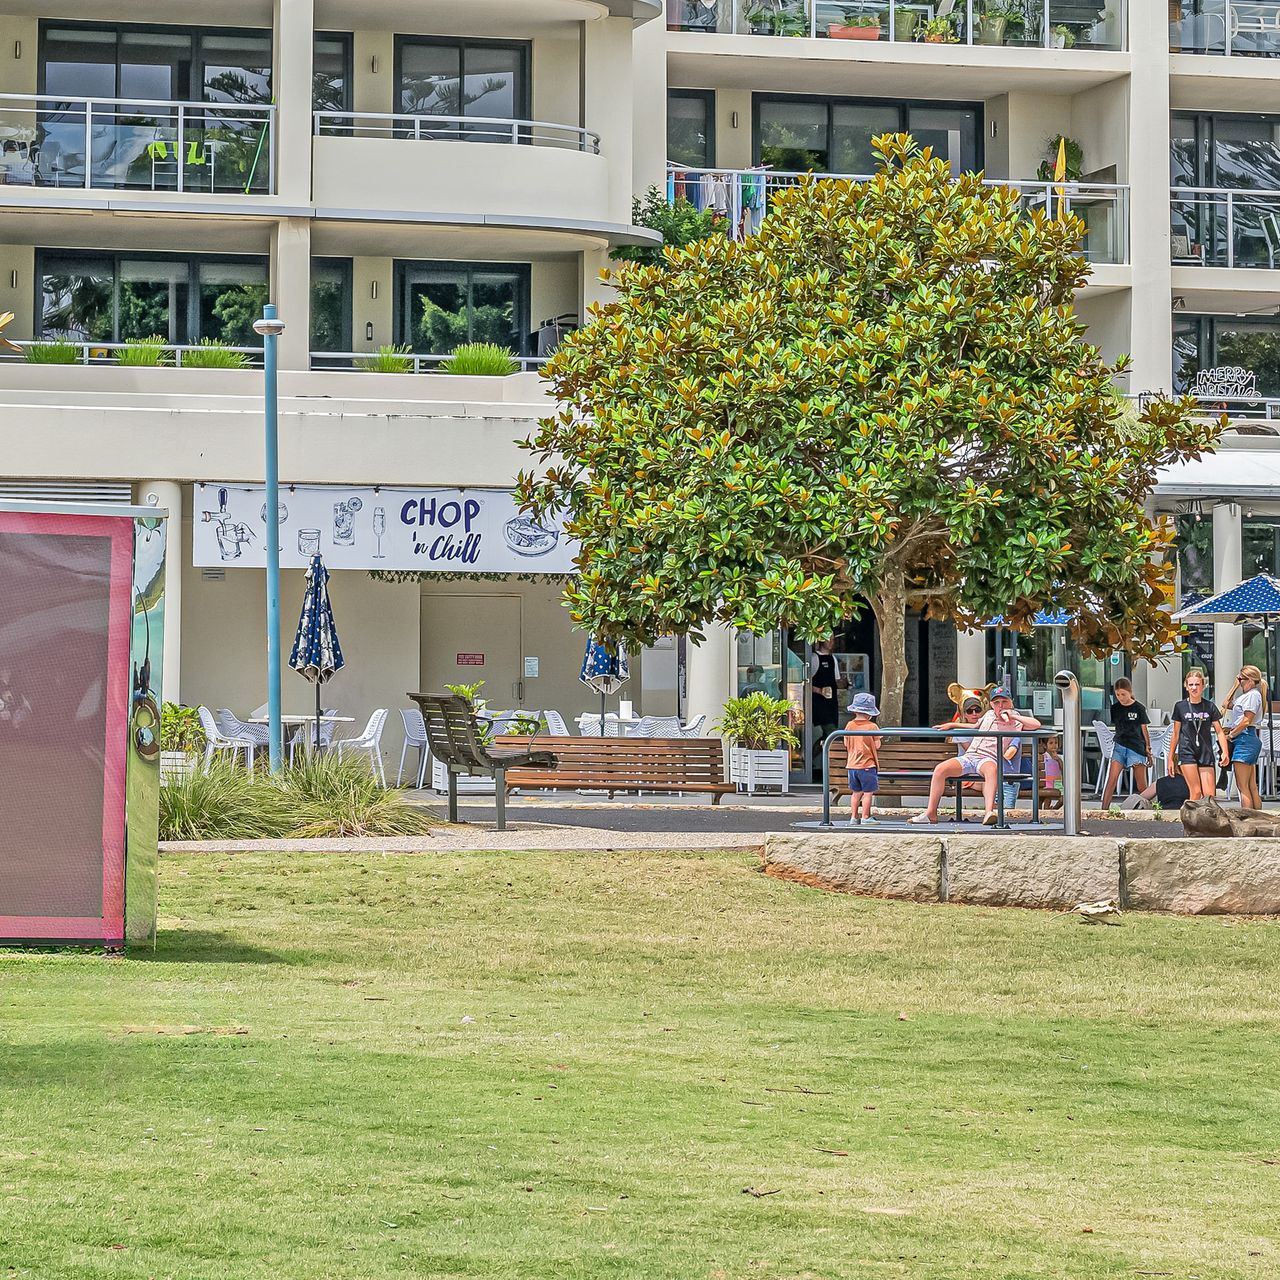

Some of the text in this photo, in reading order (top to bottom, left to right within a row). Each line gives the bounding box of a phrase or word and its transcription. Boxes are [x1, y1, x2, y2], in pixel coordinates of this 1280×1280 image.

[1199, 366, 1253, 385] MERRY
[400, 497, 480, 533] CHOP
[412, 531, 482, 564] 'n Chill
